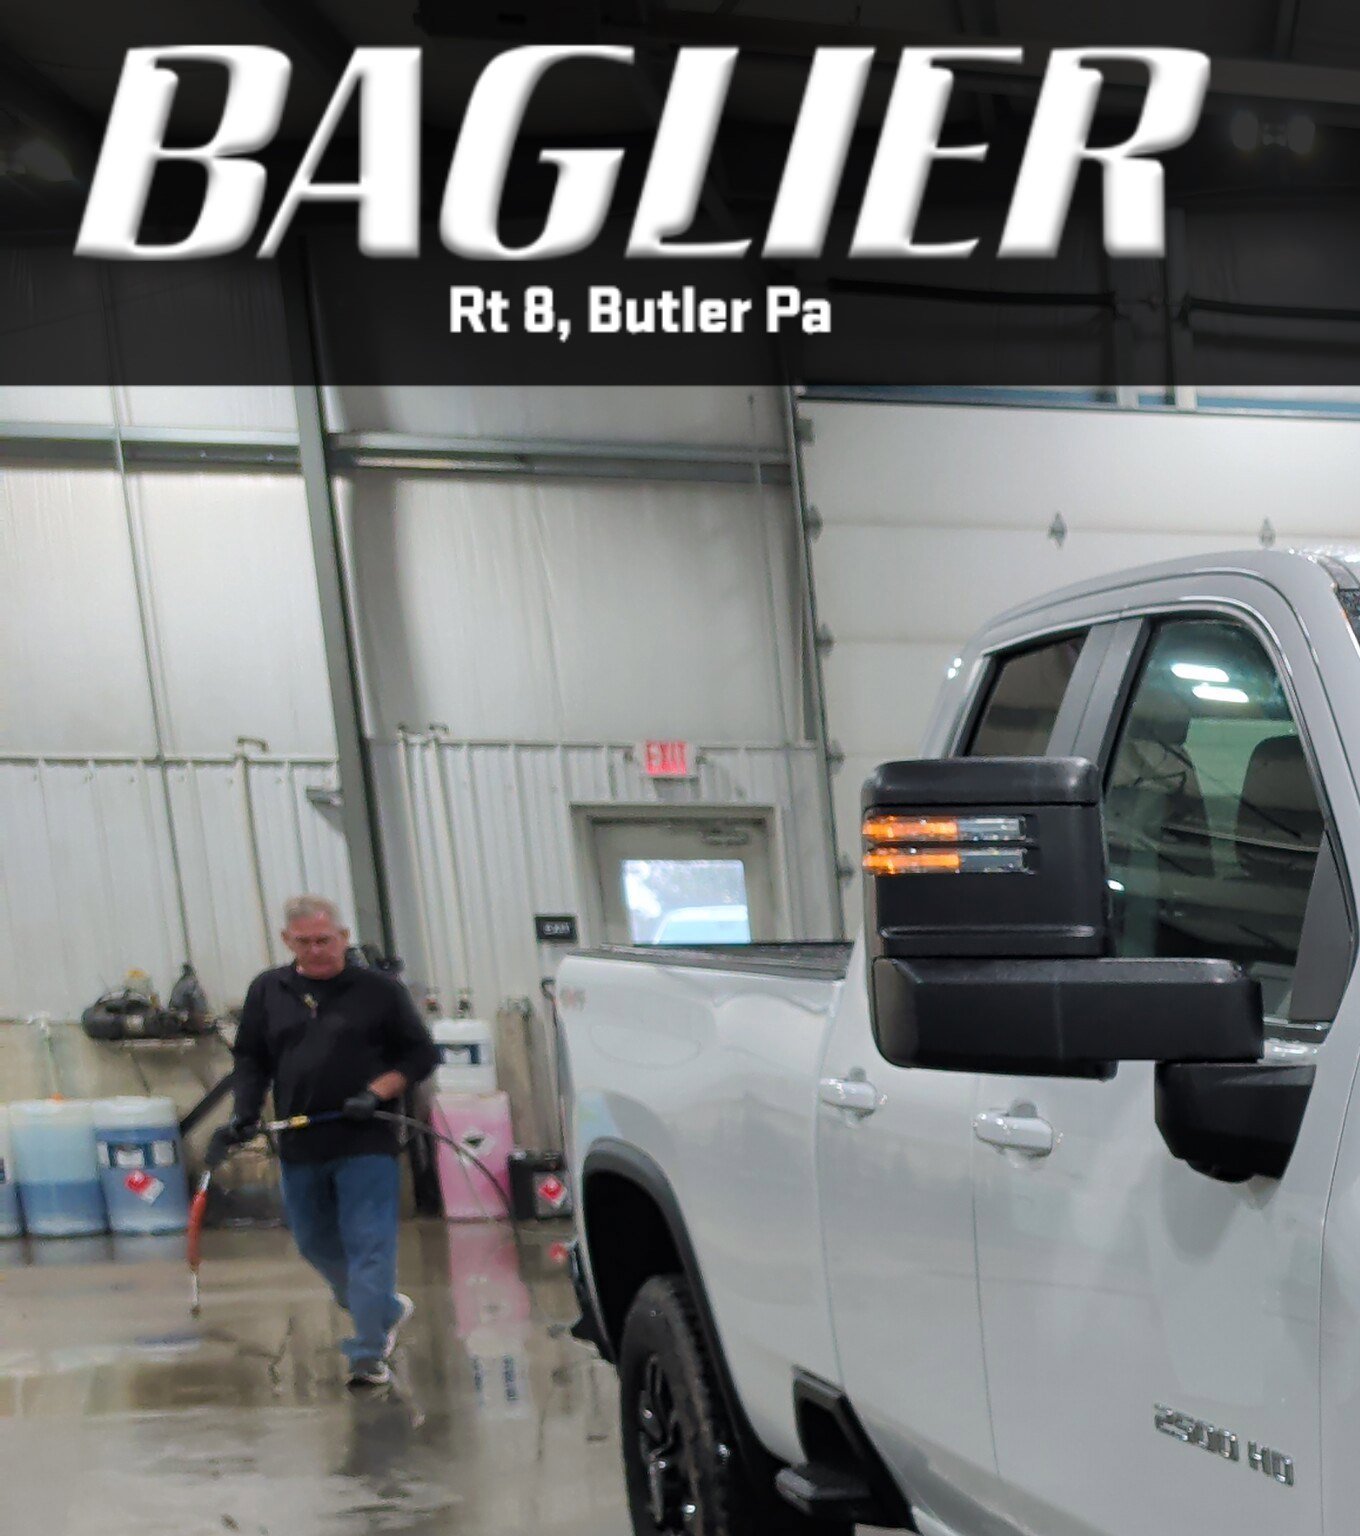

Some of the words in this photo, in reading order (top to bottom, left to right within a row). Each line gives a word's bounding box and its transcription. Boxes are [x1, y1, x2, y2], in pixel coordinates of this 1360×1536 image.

[645, 740, 687, 775] EXIT
[1153, 1401, 1240, 1462] 2500
[1247, 1440, 1295, 1487] HD
